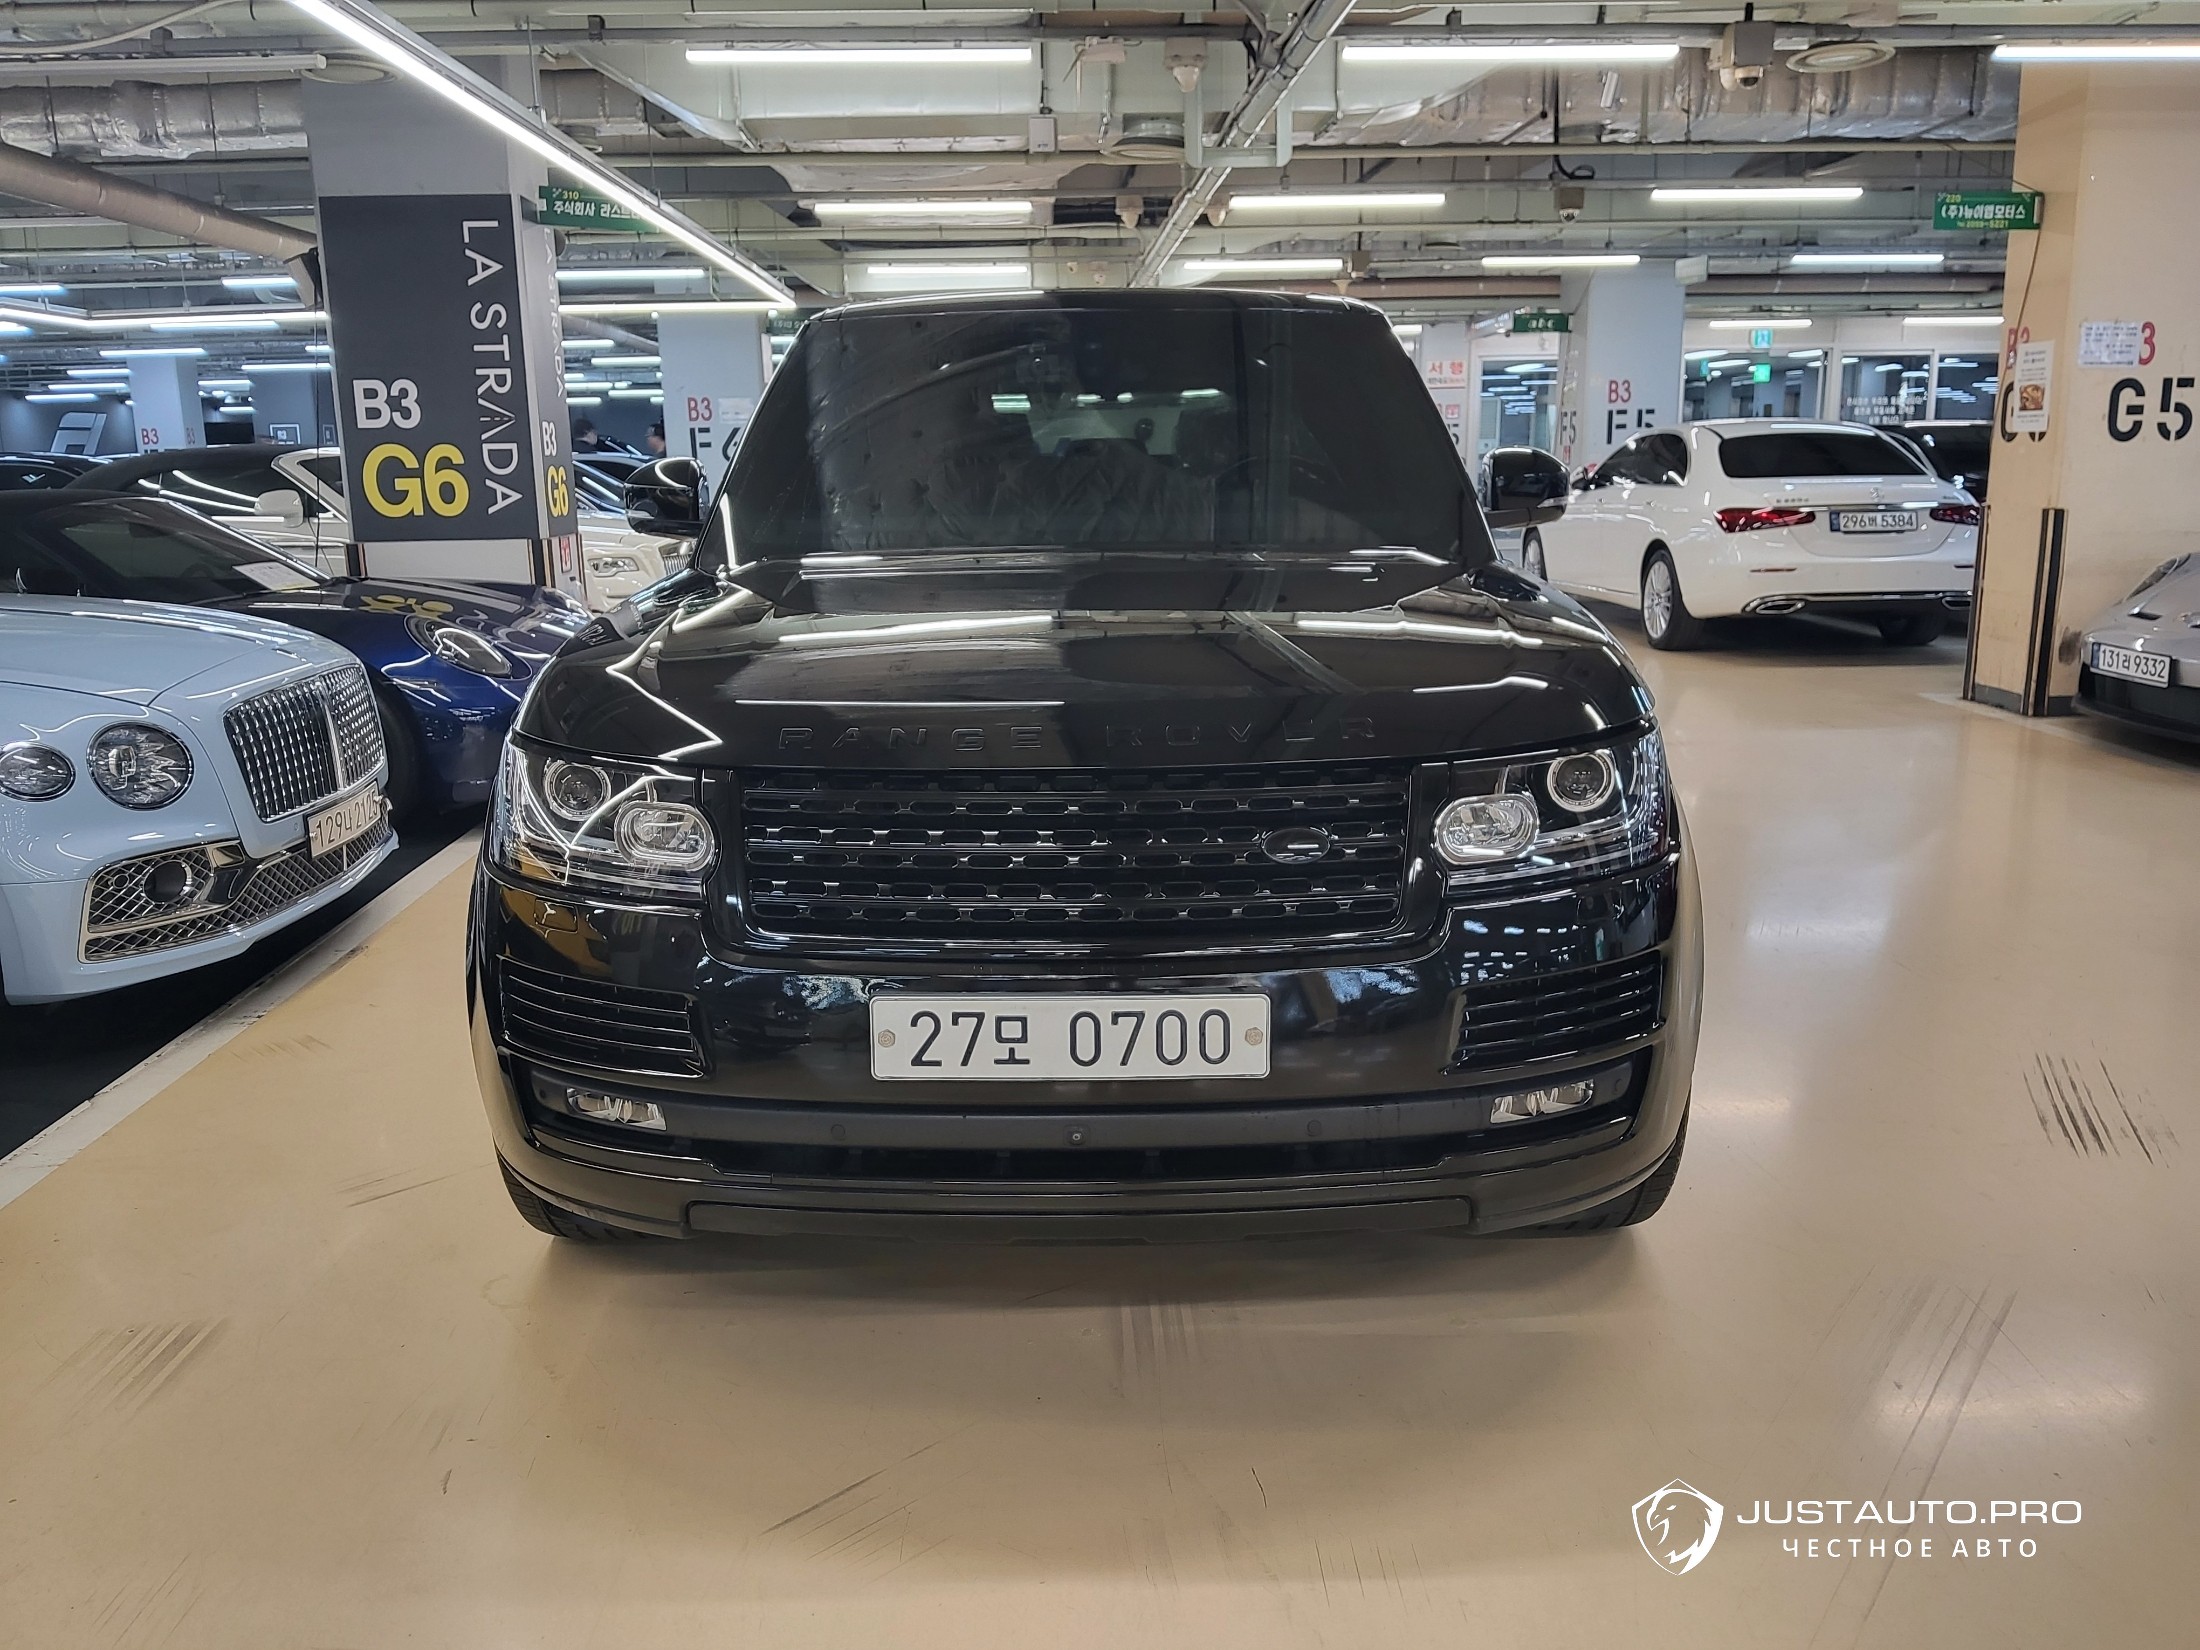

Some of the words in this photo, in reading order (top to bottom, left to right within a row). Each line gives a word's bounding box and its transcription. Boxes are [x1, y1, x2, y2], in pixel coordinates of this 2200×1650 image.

[553, 201, 595, 217] 주식회사
[562, 190, 579, 200] 310
[462, 220, 503, 286] LA
[352, 378, 421, 429] B3
[470, 302, 523, 515] STRADA
[688, 396, 713, 421] B3
[1608, 380, 1632, 403] B3
[2107, 377, 2195, 442] G5
[141, 428, 159, 445] B3
[542, 421, 558, 456] B3
[362, 443, 470, 518] G6
[547, 465, 569, 518] G6
[1842, 514, 1878, 529] 296버
[1881, 513, 1914, 528] 5384
[2134, 655, 2167, 679] 9332
[779, 726, 1043, 751] RANGE
[1105, 717, 1376, 748] ROVER
[910, 1010, 1030, 1066] 27모
[1069, 1008, 1231, 1067] 0700
